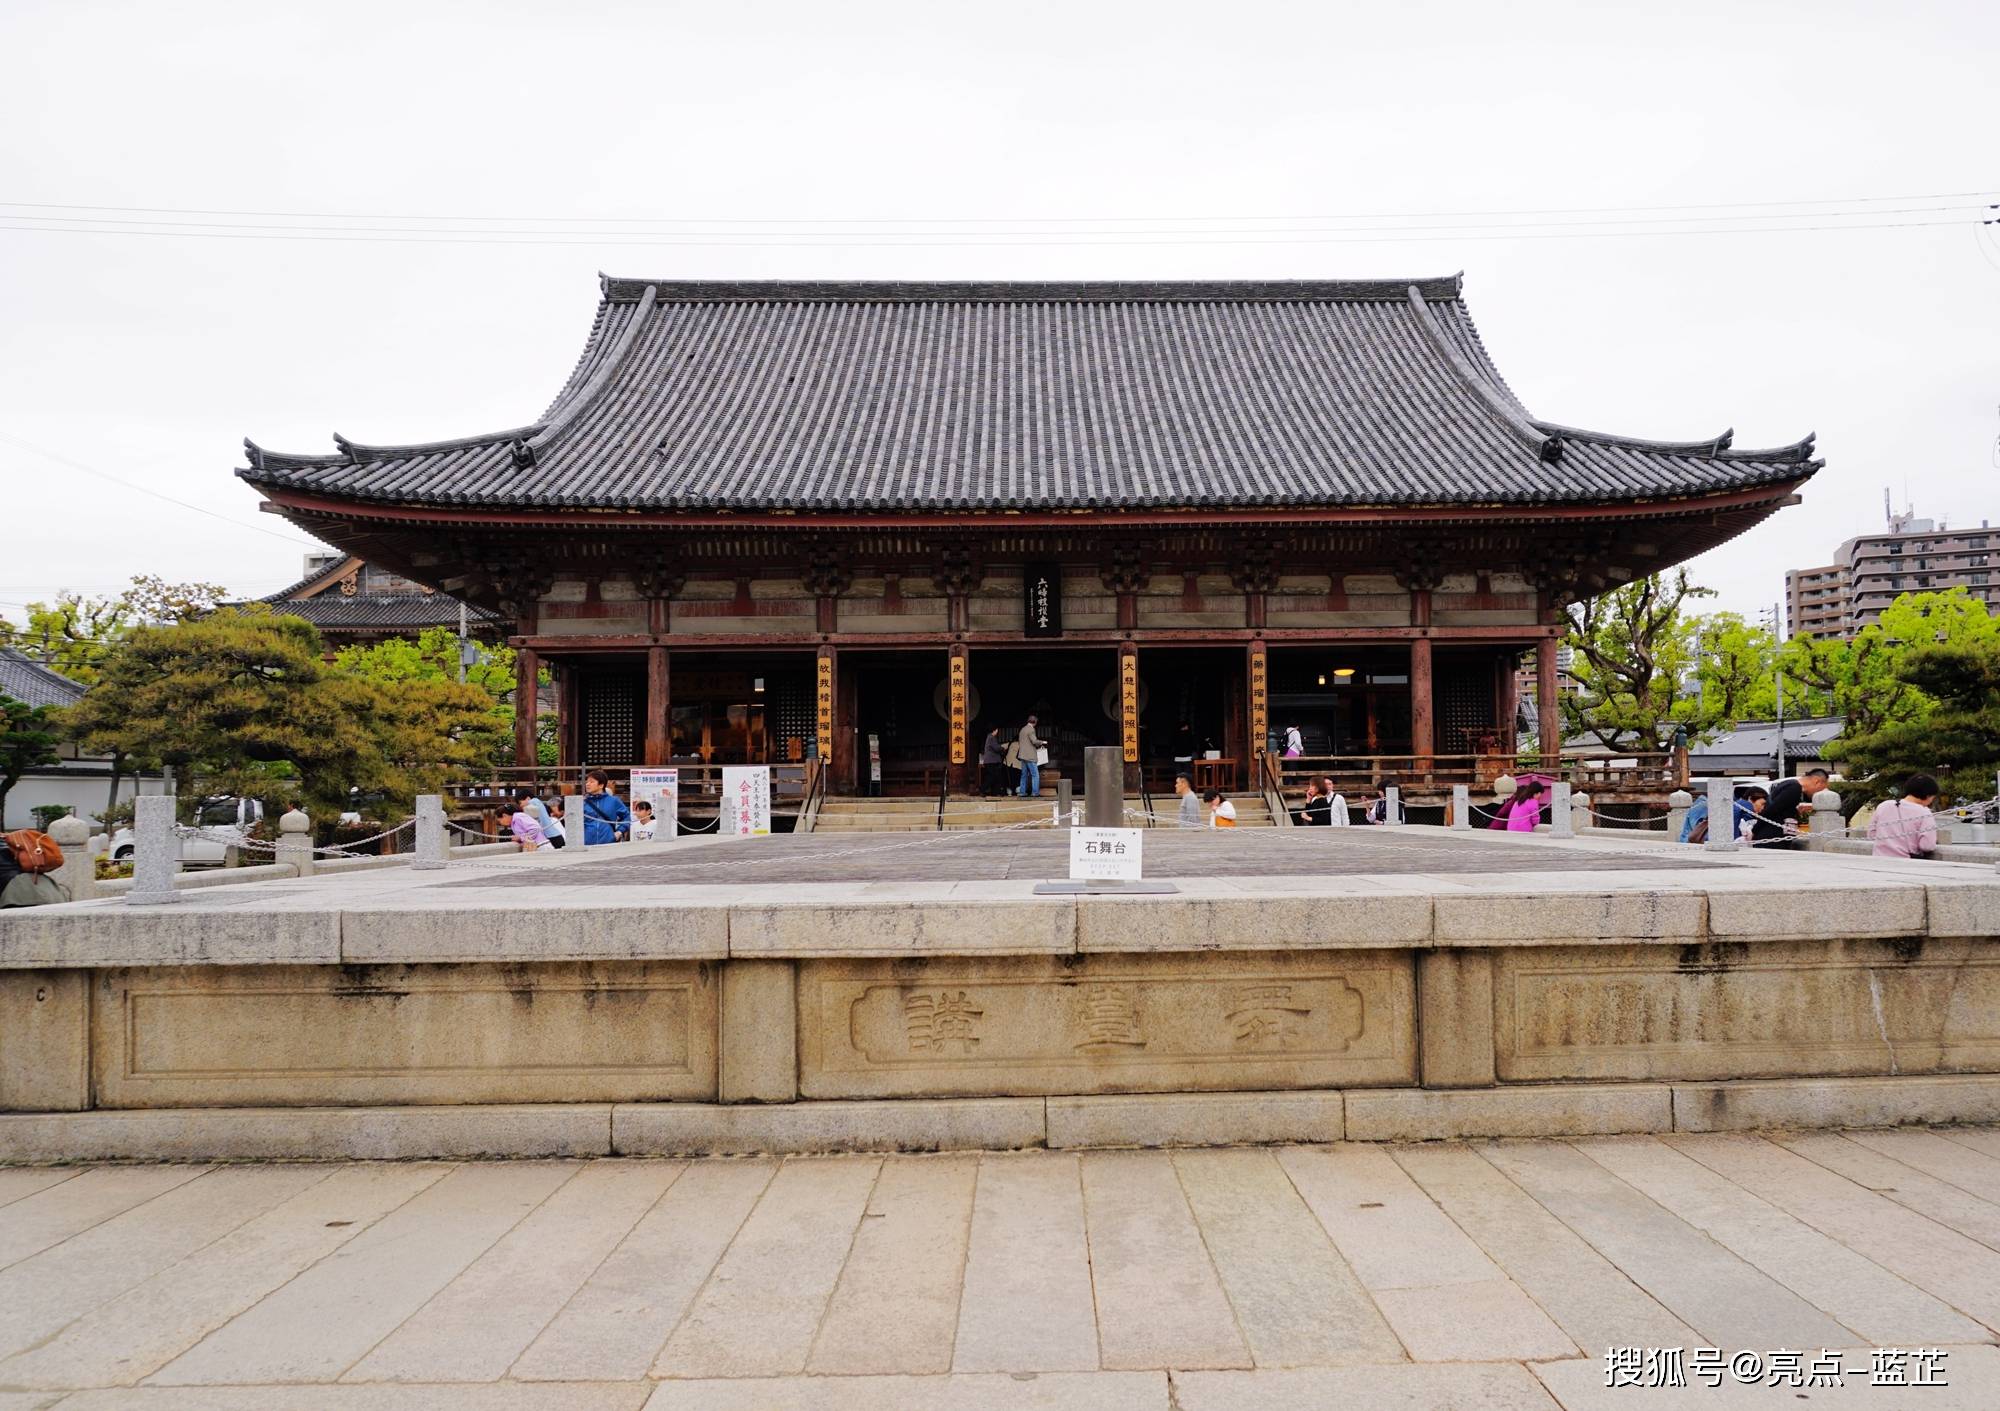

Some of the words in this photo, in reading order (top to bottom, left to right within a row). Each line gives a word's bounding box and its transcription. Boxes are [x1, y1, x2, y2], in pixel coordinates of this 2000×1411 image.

[1123, 662, 1137, 757] 大慈大悲照光明
[1085, 841, 1127, 854] 石舞台
